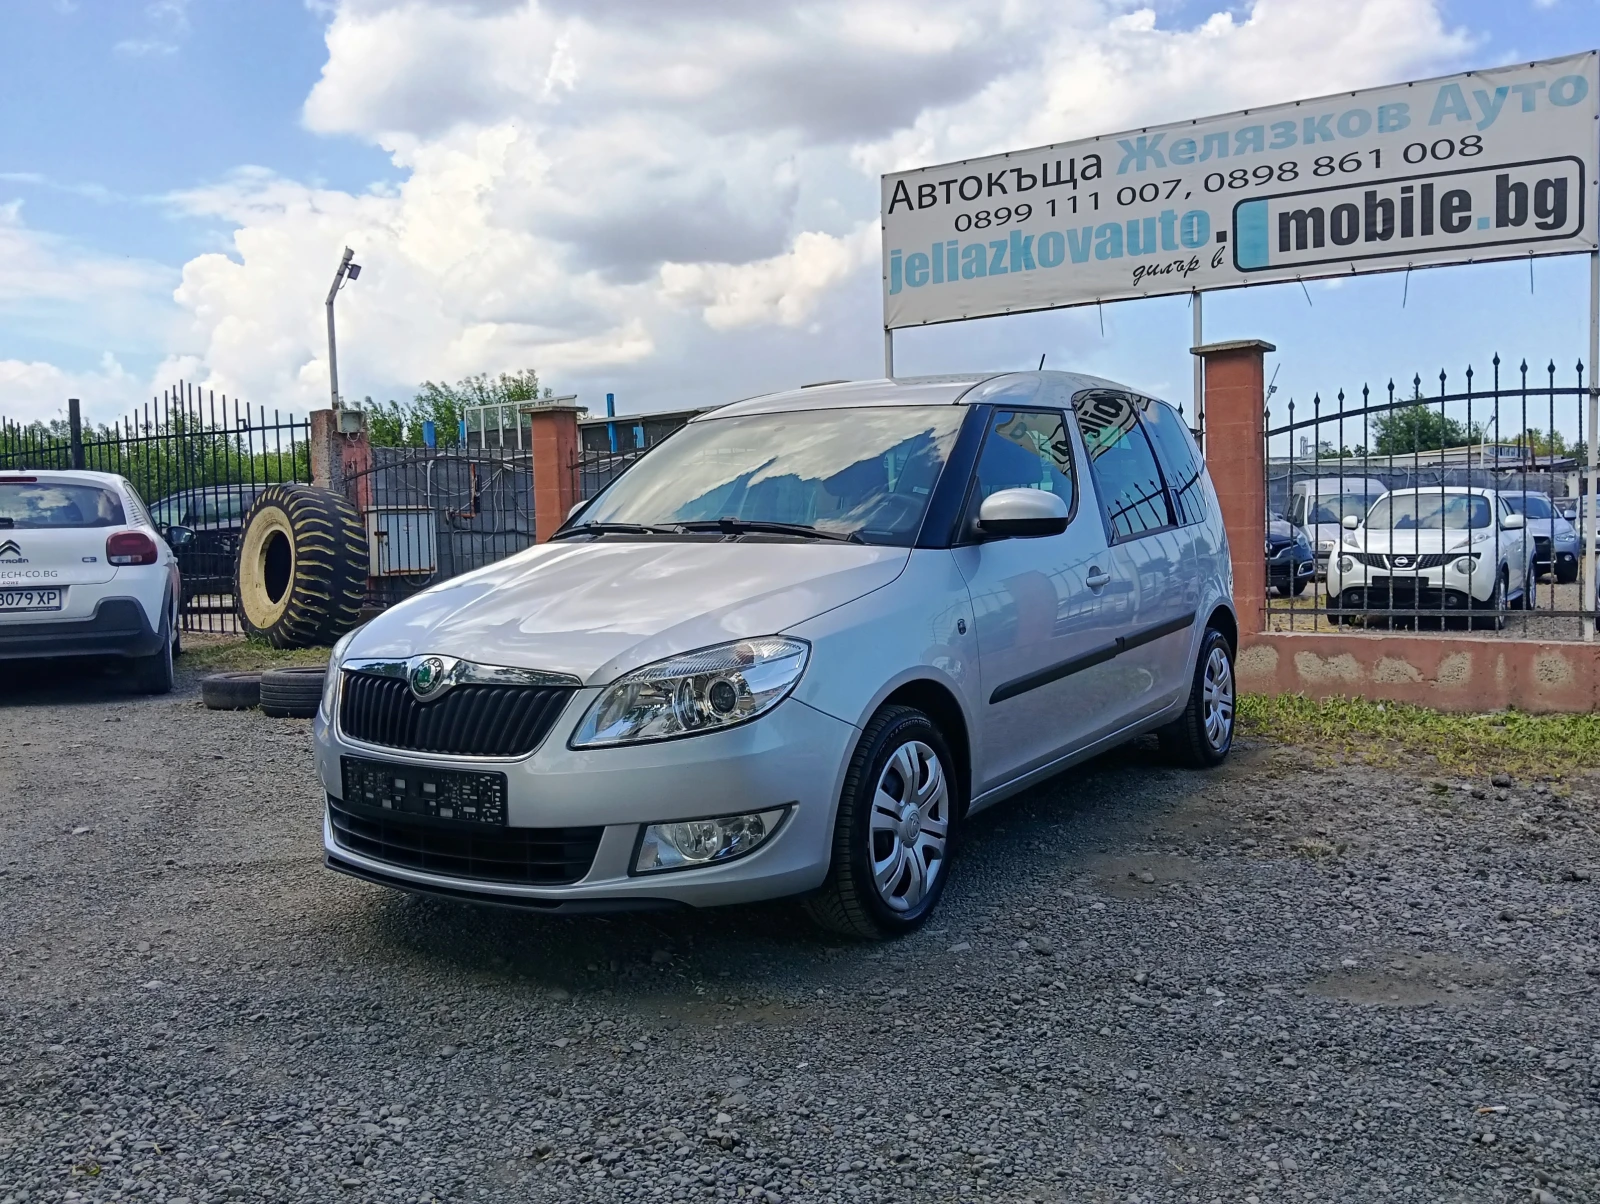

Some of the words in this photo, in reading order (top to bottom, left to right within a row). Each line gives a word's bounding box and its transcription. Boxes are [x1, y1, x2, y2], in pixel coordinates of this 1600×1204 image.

[888, 153, 1103, 215] Автокъща
[1116, 101, 1412, 176] Желязков
[1428, 74, 1590, 131] Ауто
[954, 203, 1033, 232] 0899
[1046, 192, 1100, 218] 111
[1116, 178, 1192, 207] 007,
[1203, 161, 1300, 193] 0898
[1312, 148, 1382, 177] 861
[1402, 134, 1484, 164] 008
[1278, 173, 1568, 253] mobile.bg
[1133, 253, 1201, 287] дилър
[0, 570, 58, 579] ECH-CO.BG
[37, 591, 57, 605] XP
